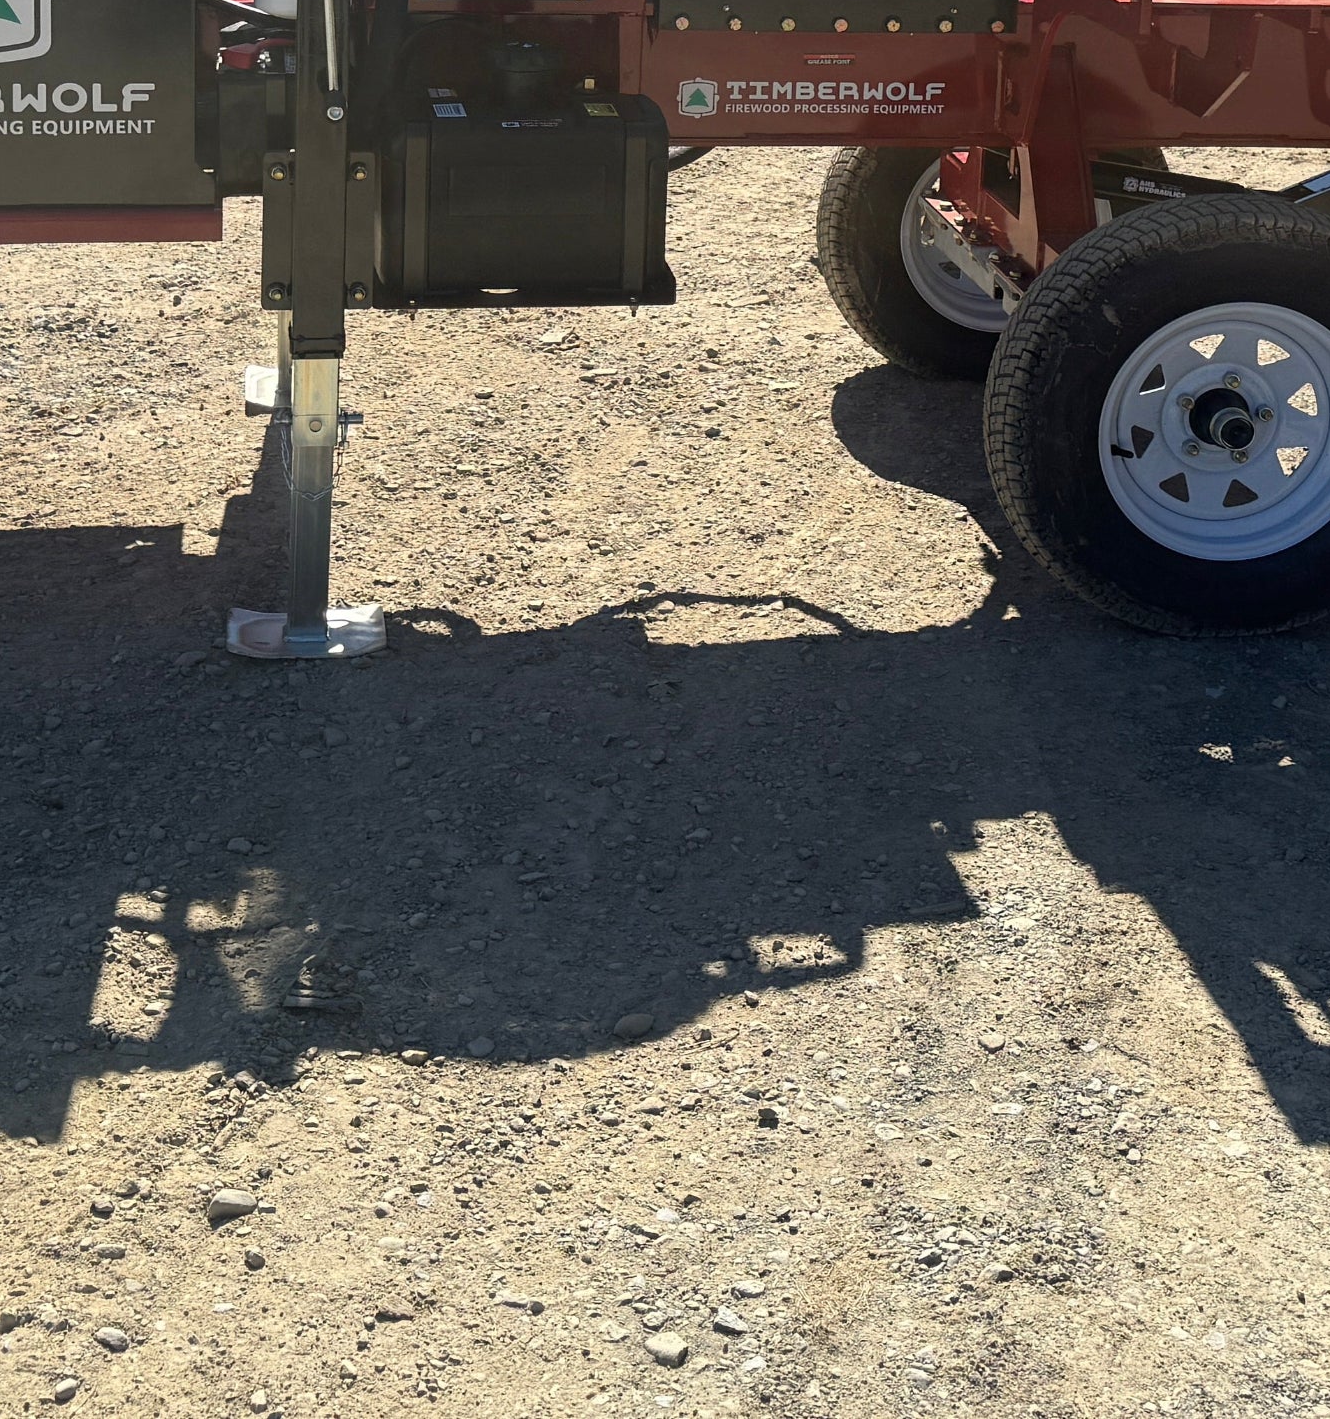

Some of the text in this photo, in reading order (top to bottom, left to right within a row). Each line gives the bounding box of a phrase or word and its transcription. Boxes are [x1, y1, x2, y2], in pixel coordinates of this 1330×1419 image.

[725, 80, 946, 102] TIMBERWOLF
[725, 103, 945, 115] FIREWOOD PROCESSING EQUIPMENT
[32, 118, 156, 137] EQUIPMENT
[1138, 185, 1186, 198] HYDRAULICS
